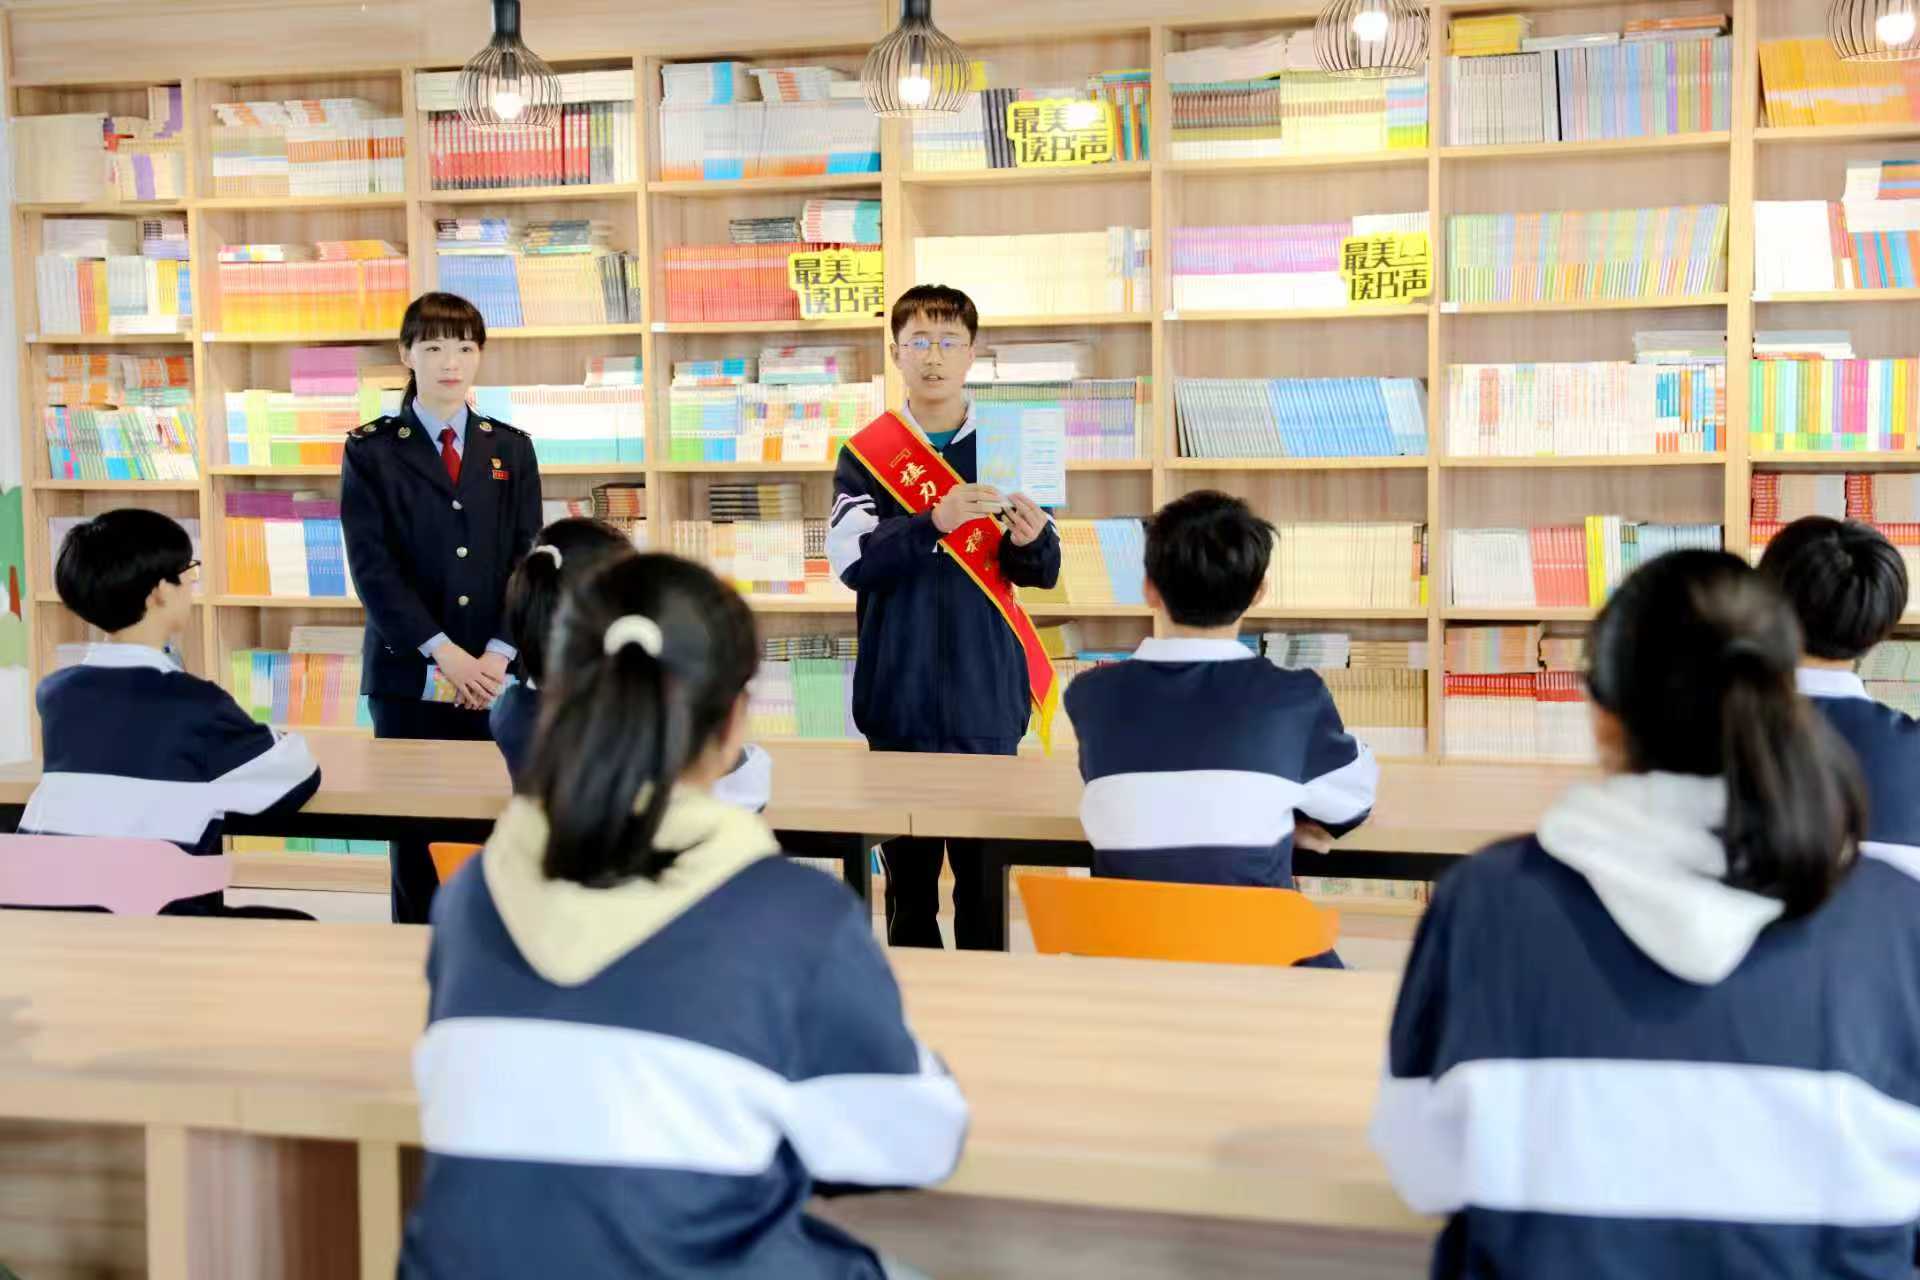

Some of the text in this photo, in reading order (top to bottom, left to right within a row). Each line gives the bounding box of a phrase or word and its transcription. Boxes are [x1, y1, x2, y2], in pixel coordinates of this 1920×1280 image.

[1013, 105, 1066, 138] 最美
[1022, 134, 1107, 162] 读书声
[795, 255, 849, 290] 最美
[1345, 237, 1395, 275] 最美
[1351, 269, 1427, 300] 读书声
